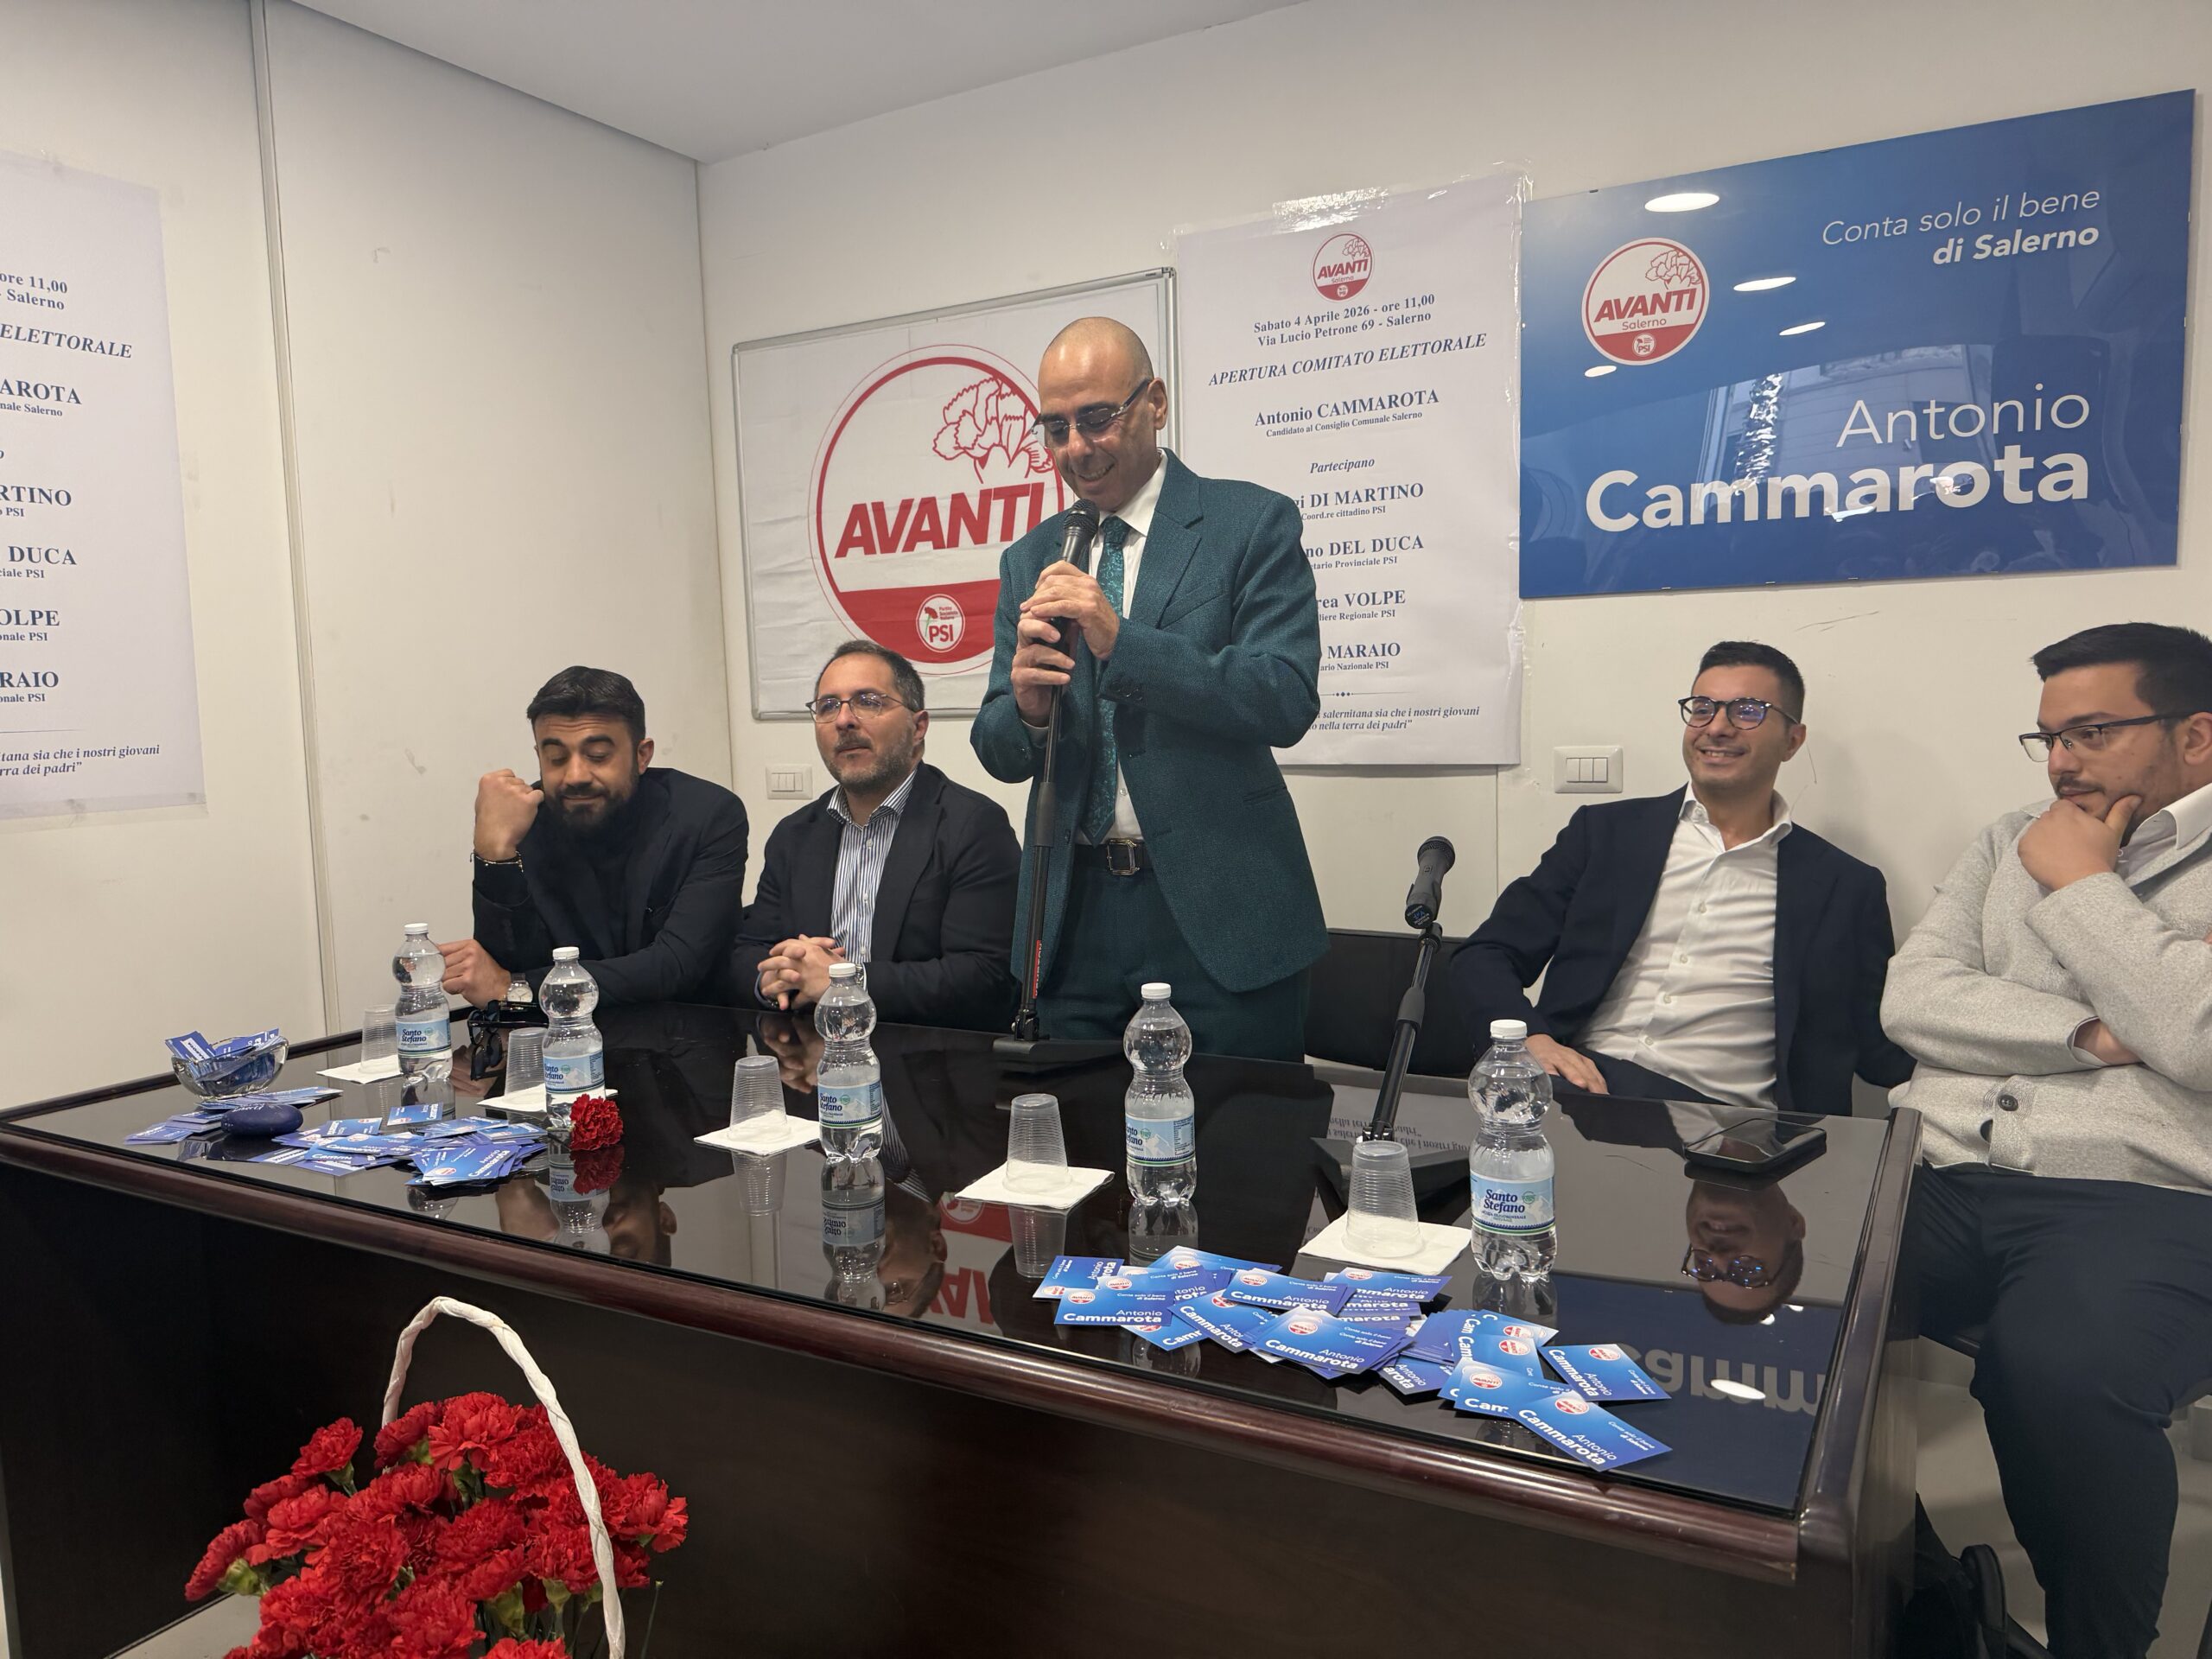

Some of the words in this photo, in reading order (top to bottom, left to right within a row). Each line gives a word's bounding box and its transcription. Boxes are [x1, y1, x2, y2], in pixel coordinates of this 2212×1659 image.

[1822, 216, 1909, 245] Conta
[1919, 201, 1981, 232] solo
[1993, 194, 2009, 222] il
[2019, 190, 2101, 218] bene
[1933, 237, 1964, 264] di
[1972, 227, 2100, 260] Salerno
[1317, 259, 1369, 279] AVANTI
[0, 272, 24, 285] ore
[29, 276, 68, 294] 11,00
[7, 289, 65, 310] Salerno
[1593, 288, 1697, 323] AVANTI
[1254, 319, 1292, 333] Sabato
[1294, 316, 1300, 327] 4
[1305, 310, 1340, 327] Aprile
[1344, 305, 1370, 319] 2026
[1382, 302, 1401, 313] ore
[1404, 294, 1434, 309] 11,00
[1258, 336, 1276, 346] Via
[1280, 331, 1311, 344] Lucio
[1315, 324, 1357, 339] Petrone
[1362, 319, 1375, 331] 69
[1386, 313, 1432, 327] Salerno
[1622, 318, 1667, 331] Salerno
[0, 323, 133, 359] ELETTORALE
[1637, 344, 1650, 353] PSI
[1209, 364, 1287, 386] APERTURA
[1293, 350, 1374, 374] COMITATO
[1379, 333, 1487, 363] ELETTORALE
[0, 378, 82, 405] AROTA
[24, 403, 63, 416] Salerno
[1255, 405, 1313, 426] Antonio
[1317, 389, 1440, 419] CAMMAROTA
[1835, 384, 2090, 448] Antonio
[1266, 424, 1305, 437] Candidato
[1315, 420, 1350, 432] Consiglio
[1351, 414, 1390, 427] Comunale
[1392, 410, 1422, 422] Salerno
[1310, 458, 1375, 474] Partecipano
[1310, 493, 1329, 508] DI
[1334, 482, 1424, 505] MARTINO
[1586, 444, 2089, 533] Cammarota
[6, 506, 25, 518] PSI
[834, 482, 1045, 559] AVANTI
[1301, 512, 1334, 521] Coord.re
[1336, 508, 1370, 518] cittadino
[1372, 505, 1386, 514] PSI
[1329, 540, 1365, 556] DEL
[1371, 535, 1424, 553] DUCA
[8, 545, 78, 566] DUCA
[1335, 557, 1381, 569] Provinciale
[1382, 556, 1398, 565] PSI
[26, 569, 45, 579] PSI
[1344, 589, 1406, 607] VOLPE
[1339, 611, 1378, 621] Regionale
[1381, 609, 1395, 618] PSI
[29, 632, 48, 641] PSI
[929, 624, 954, 643] PSI
[1327, 642, 1402, 659] MARAIO
[1337, 661, 1374, 671] Nazionale
[1376, 661, 1389, 670] PSI
[0, 671, 60, 689] RAIO
[28, 693, 46, 702] PSI
[1323, 709, 1373, 719] salernitana
[1375, 708, 1389, 718] sia
[1390, 708, 1406, 717] che
[1408, 707, 1412, 717] i
[1414, 707, 1441, 717] nostri
[1442, 706, 1480, 718] giovani
[1319, 720, 1339, 731] nella
[1342, 721, 1364, 730] terra
[1366, 720, 1381, 729] dei
[33, 749, 49, 760] sia
[54, 748, 73, 760] che
[76, 748, 79, 758] i
[83, 747, 116, 758] nostri
[118, 745, 160, 759] giovani
[22, 764, 41, 775] dei
[401, 1035, 427, 1044] Stefano
[1485, 1189, 1518, 1202] Santo
[1484, 1198, 1525, 1214] Stefano
[1283, 1294, 1330, 1304] Antonio
[1064, 1313, 1162, 1323] Cammarota
[1180, 1305, 1243, 1348] Cammarota
[1265, 1339, 1358, 1370] Cammarota
[1319, 1349, 1365, 1363] Antonio
[1395, 1363, 1427, 1387] Antonio
[1548, 1349, 1599, 1397] Cammarota
[1584, 1372, 1613, 1396] Antonio
[1518, 1409, 1606, 1465] Cammarota
[1572, 1433, 1617, 1461] Antonio
